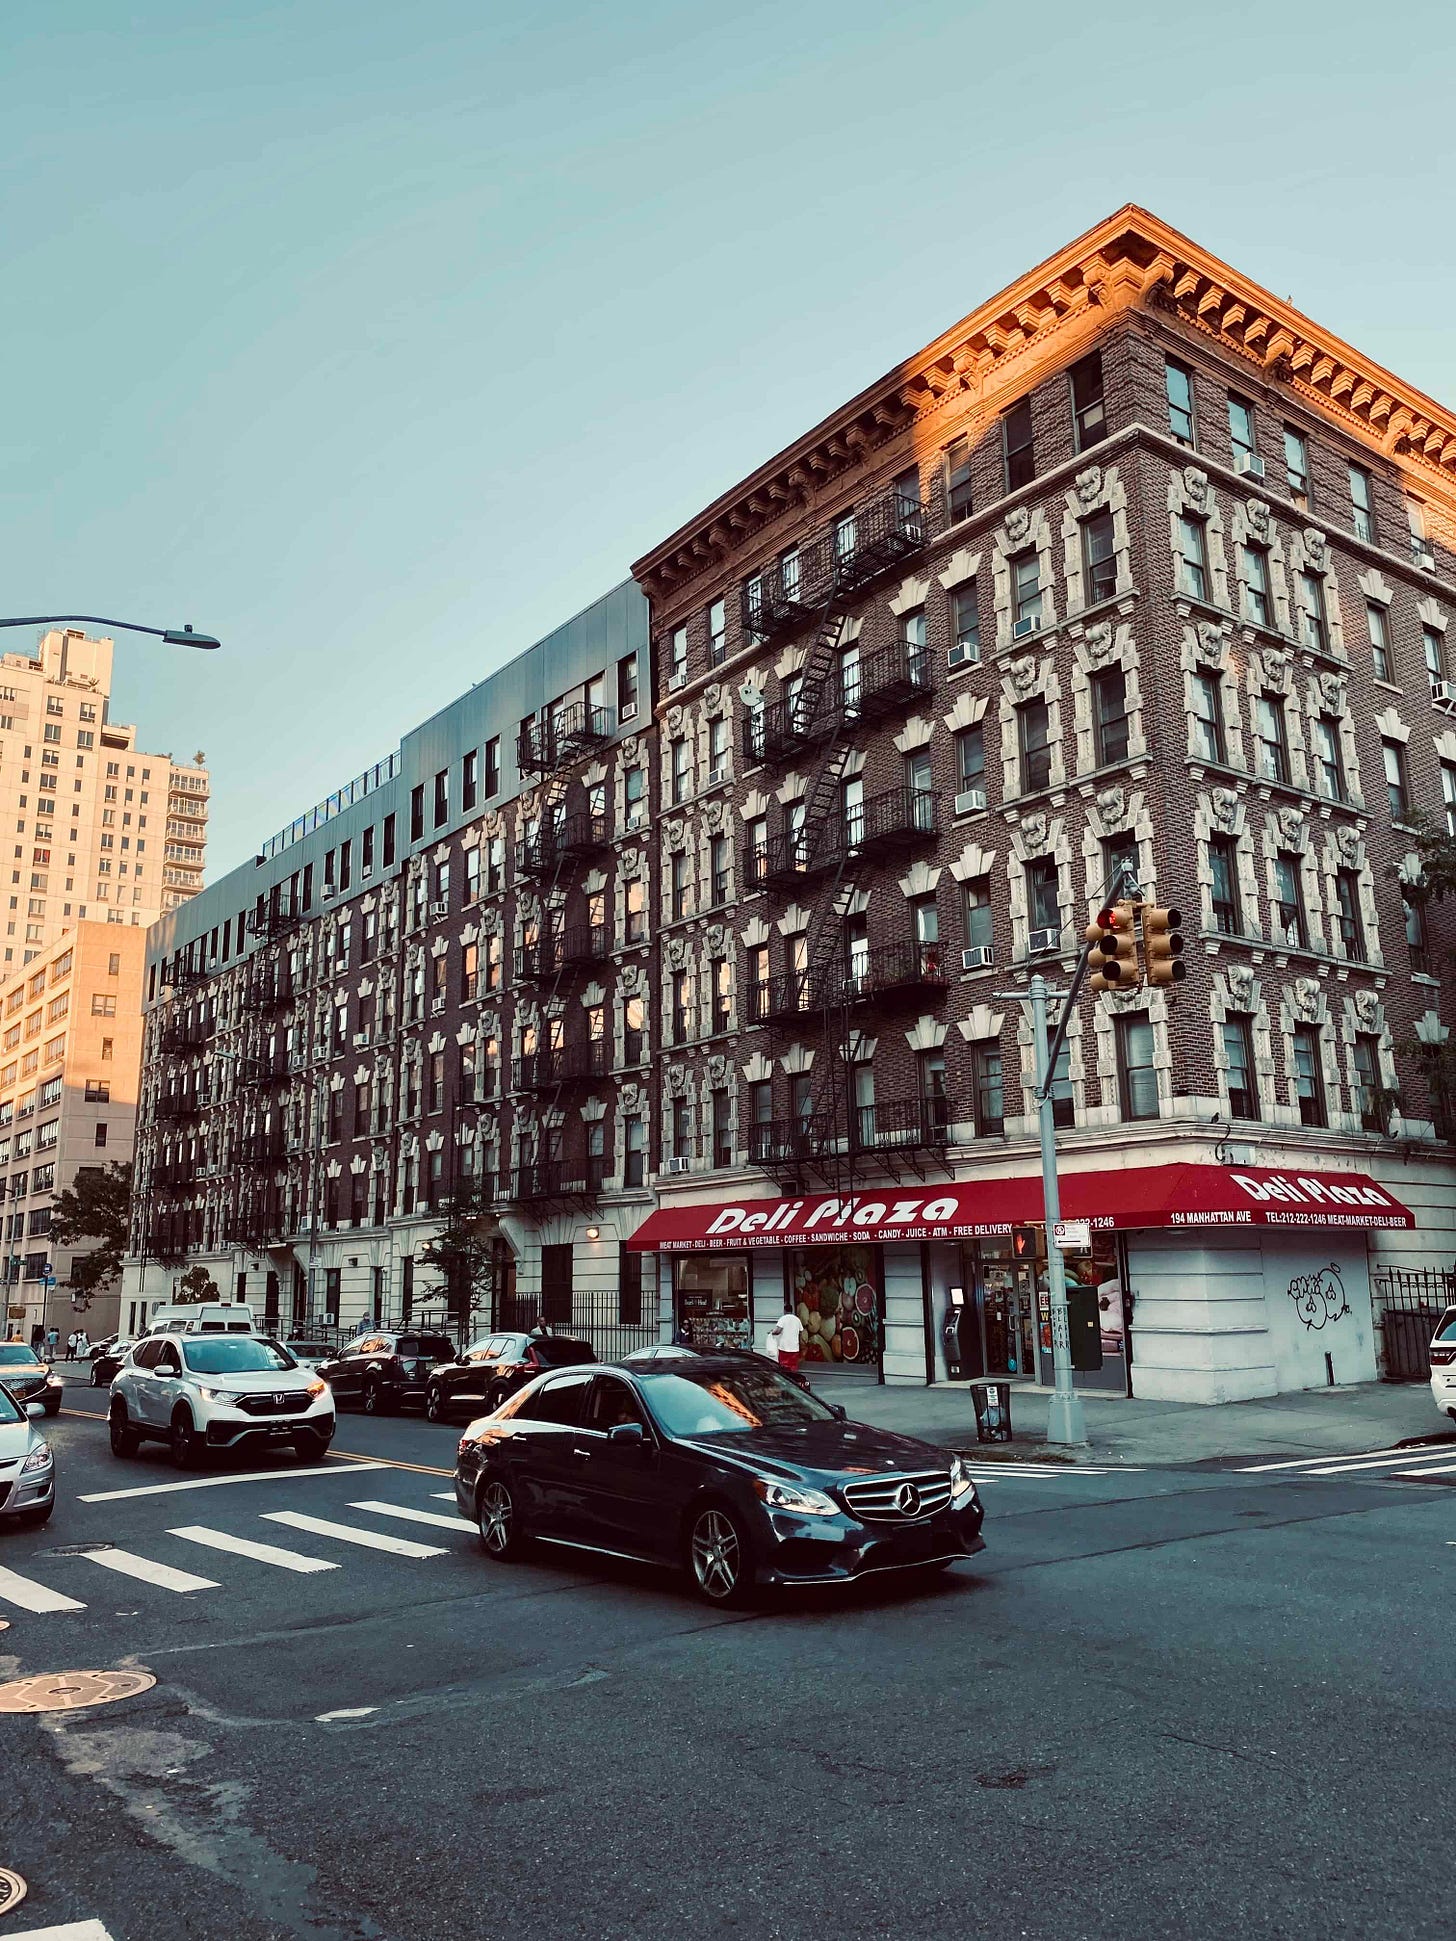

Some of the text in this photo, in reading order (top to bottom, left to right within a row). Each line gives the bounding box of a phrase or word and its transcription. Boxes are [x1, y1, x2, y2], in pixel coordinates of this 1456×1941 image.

[1229, 1174, 1392, 1207] Deli Plaza
[705, 1197, 960, 1234] Deli Plaza
[1170, 1211, 1252, 1224] 194 MANHATTAN AVE
[1265, 1211, 1327, 1225] TEL:212-222-1246
[672, 1240, 692, 1249] MARKET
[694, 1239, 706, 1249] DELI
[709, 1239, 723, 1248] BEER
[726, 1238, 742, 1247] FRUIT
[748, 1235, 780, 1246] VEGETABLE
[784, 1235, 807, 1244] COFFEE
[811, 1232, 849, 1243] SANDWICHE
[852, 1231, 871, 1241] SODA
[878, 1228, 902, 1240] CANDY
[905, 1227, 927, 1238] JUICE
[932, 1226, 948, 1237] ATM
[953, 1225, 973, 1236] FREE
[974, 1223, 1013, 1236] DELIVERY
